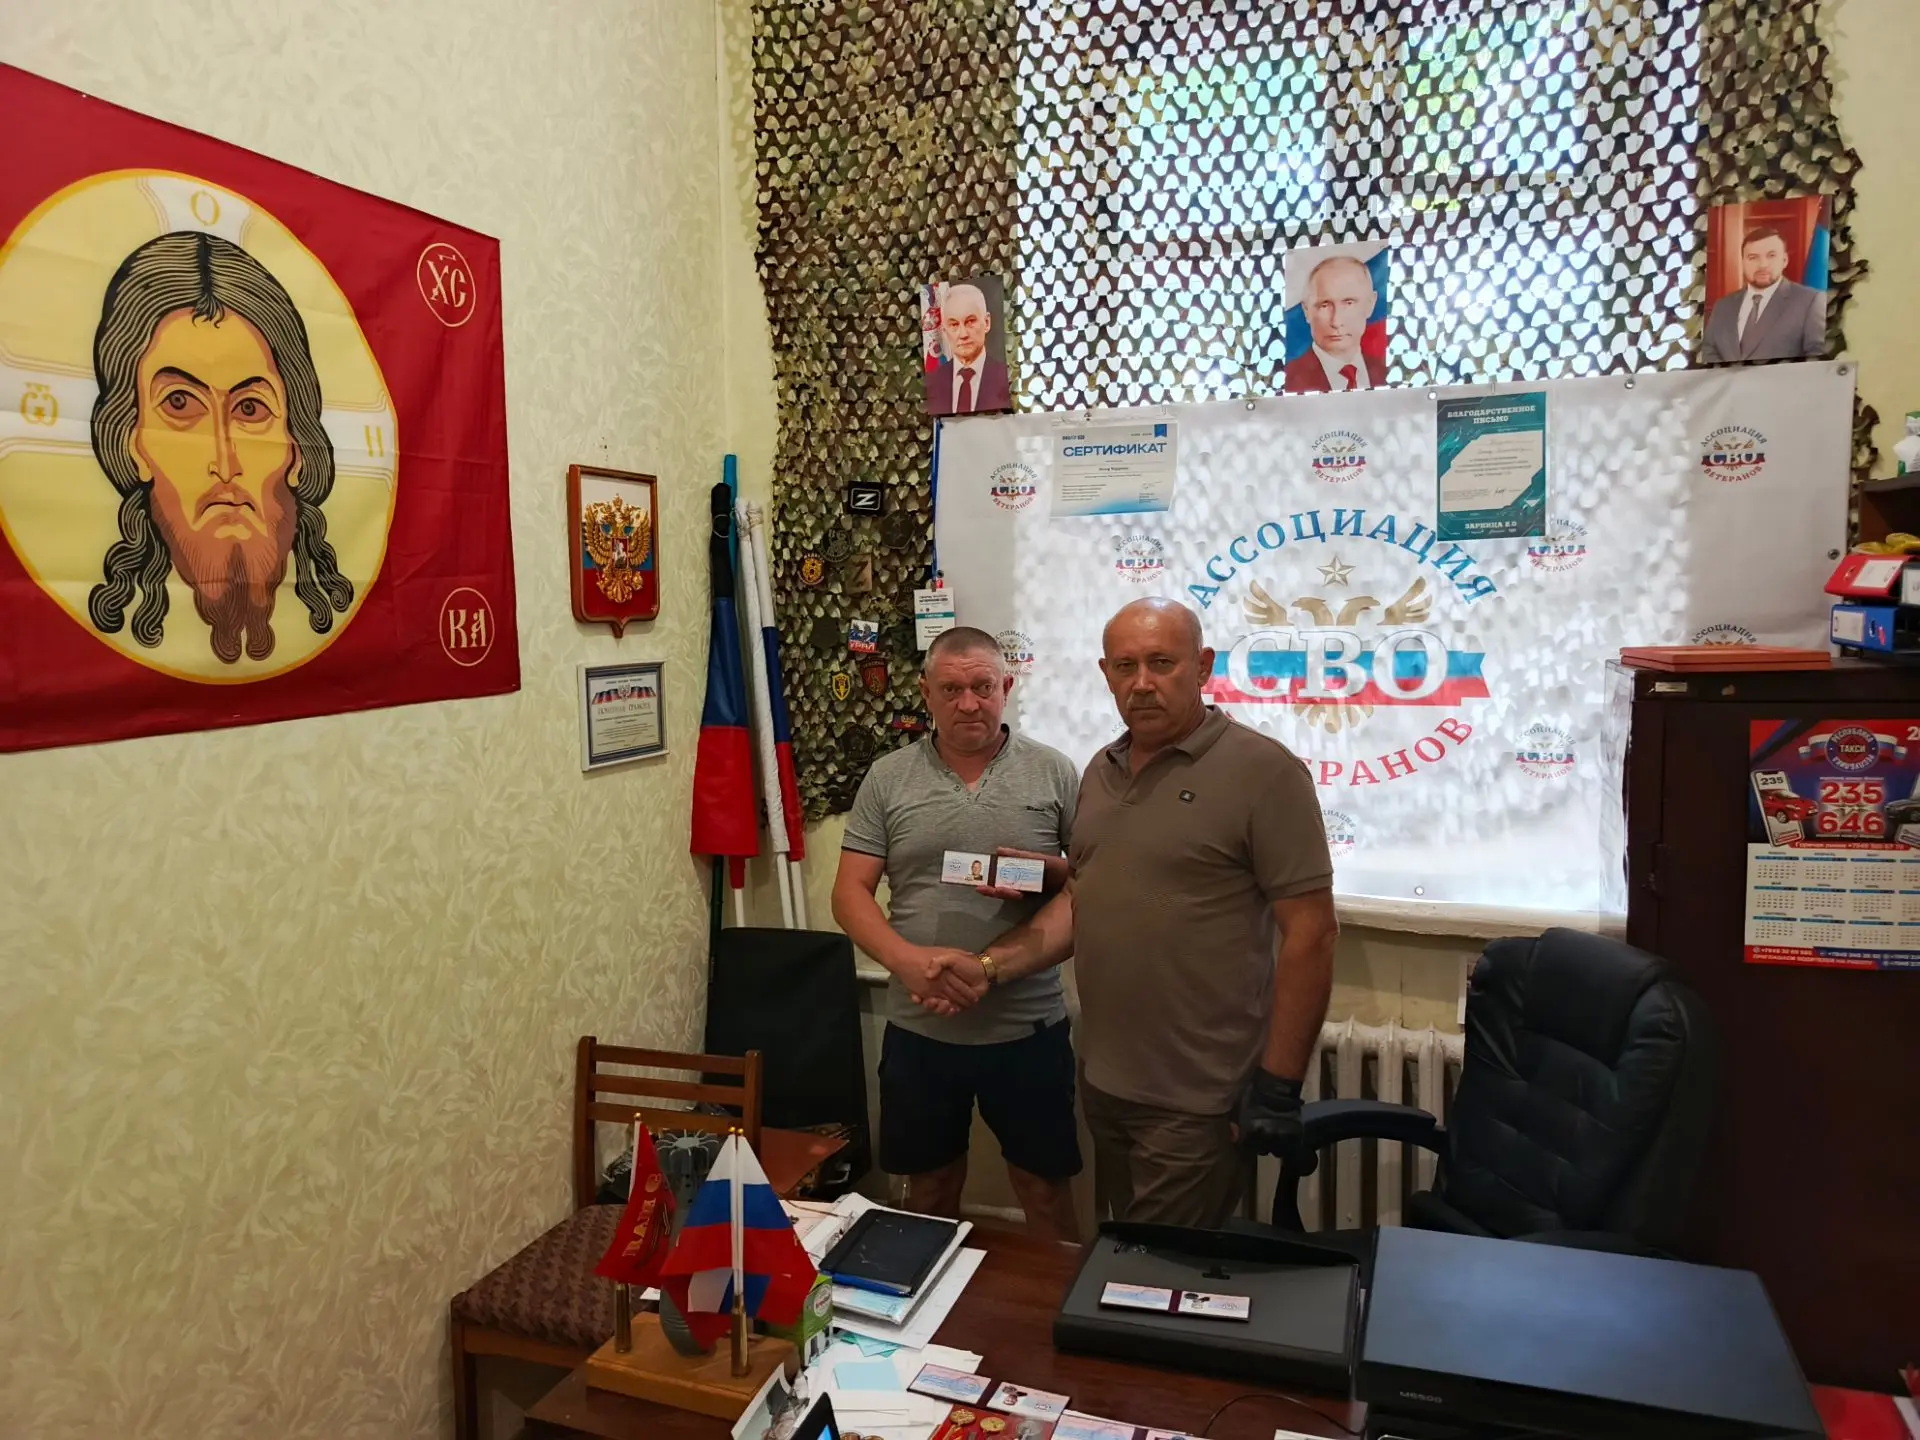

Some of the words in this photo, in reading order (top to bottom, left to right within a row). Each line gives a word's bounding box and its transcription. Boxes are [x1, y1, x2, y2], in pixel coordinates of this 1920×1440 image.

[1447, 405, 1536, 418] БЛАГОДАРСТВЕННОЕ
[1473, 415, 1509, 424] ПИСЬМО
[1312, 430, 1368, 450] АССОЦИАЦИЯ
[1701, 426, 1767, 447] АССОЦИАЦИЯ
[1063, 442, 1167, 457] СЕРТИФИКАТ
[1709, 452, 1757, 466] СВО
[1315, 467, 1364, 483] ВЕТЕРАНОВ
[1704, 466, 1762, 482] ВЕТЕРАНОВ
[854, 493, 877, 507] Z
[1187, 508, 1497, 609] АССОЦИАЦИЯ
[1691, 624, 1757, 644] АССОЦИАЦИЯ
[1228, 630, 1448, 700] СВО
[1301, 717, 1474, 787] РАНОВ
[1840, 744, 1866, 753] ТАКСИ
[1760, 777, 1784, 786] 235
[1820, 782, 1884, 804] 235
[1818, 811, 1885, 833] 646
